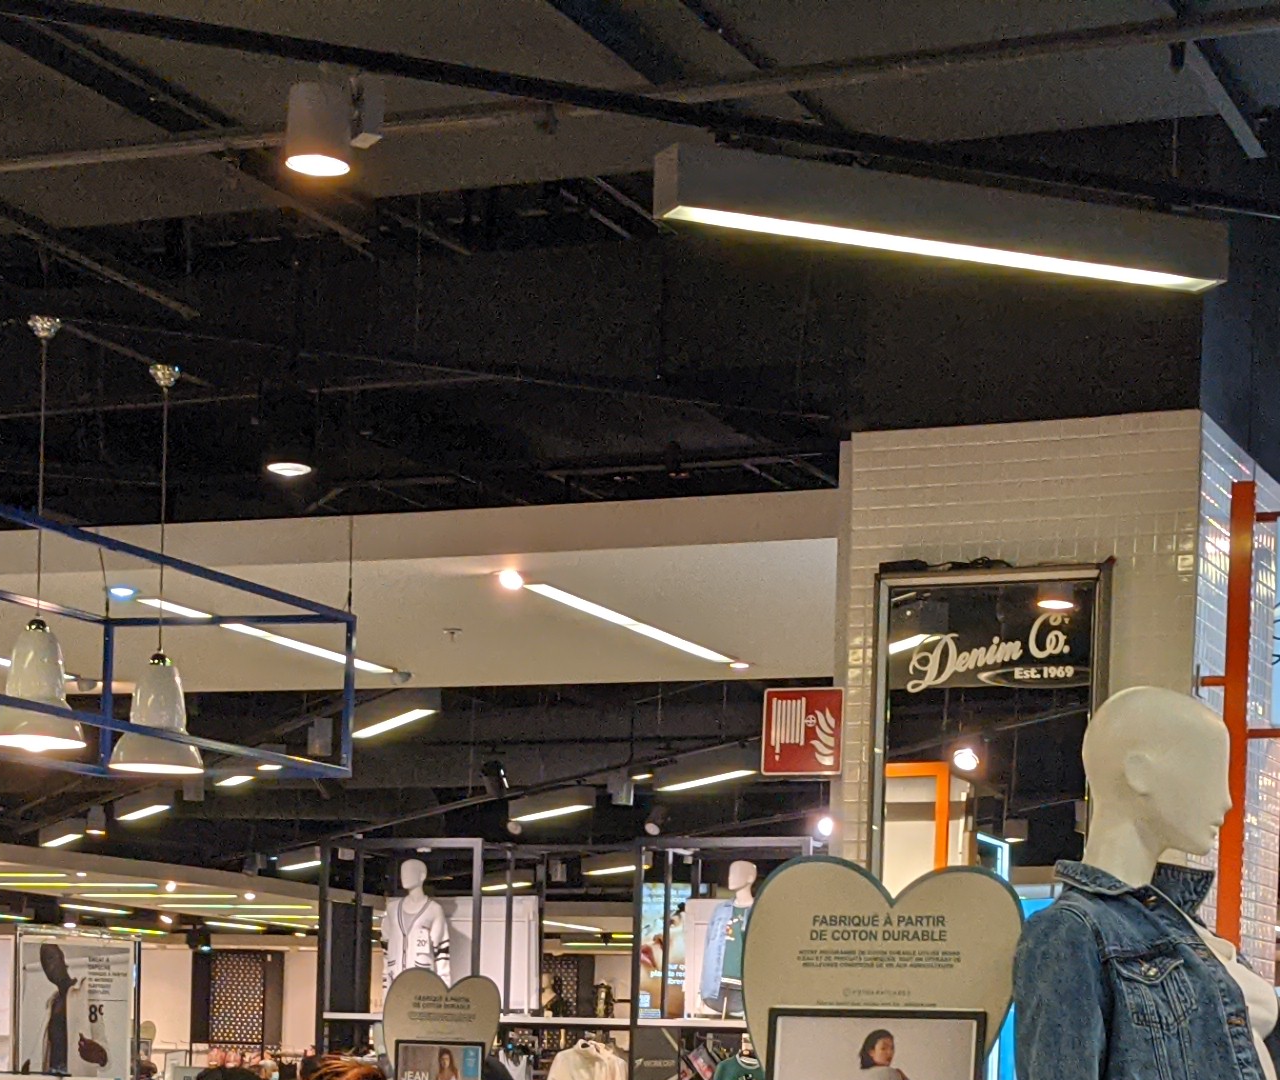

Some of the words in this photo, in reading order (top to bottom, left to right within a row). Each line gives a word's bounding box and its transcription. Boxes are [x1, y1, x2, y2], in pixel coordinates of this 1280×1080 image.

[906, 633, 1022, 693] Denim
[1028, 612, 1071, 659] Co.
[1014, 666, 1041, 679] Est.
[1042, 665, 1074, 679] 1969
[812, 913, 880, 926] FABRIQUÉ
[883, 912, 893, 926] À
[896, 915, 946, 927] PARTIR
[809, 929, 828, 941] DE
[831, 929, 878, 941] COTON
[882, 929, 947, 941] DURABLE
